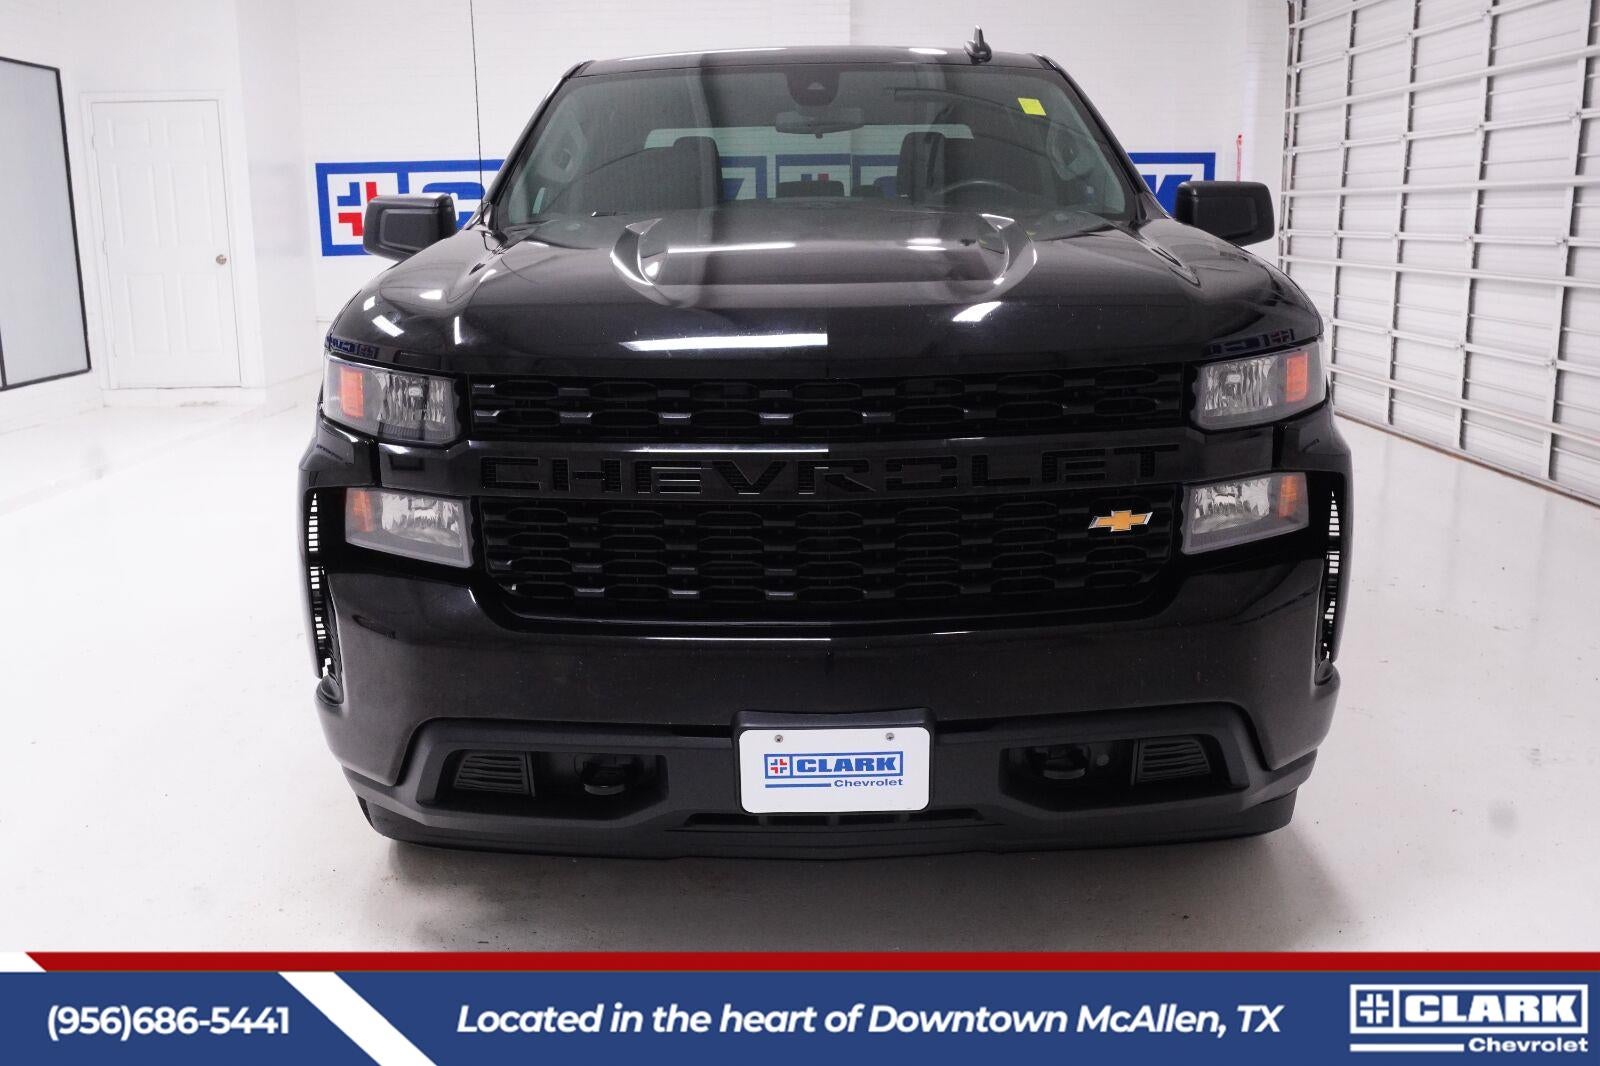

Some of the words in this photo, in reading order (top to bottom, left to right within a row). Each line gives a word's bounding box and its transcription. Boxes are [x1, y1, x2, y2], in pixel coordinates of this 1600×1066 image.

[481, 444, 1181, 494] CHEVROLET
[796, 756, 897, 773] CLARK
[833, 778, 904, 788] Chevrolet
